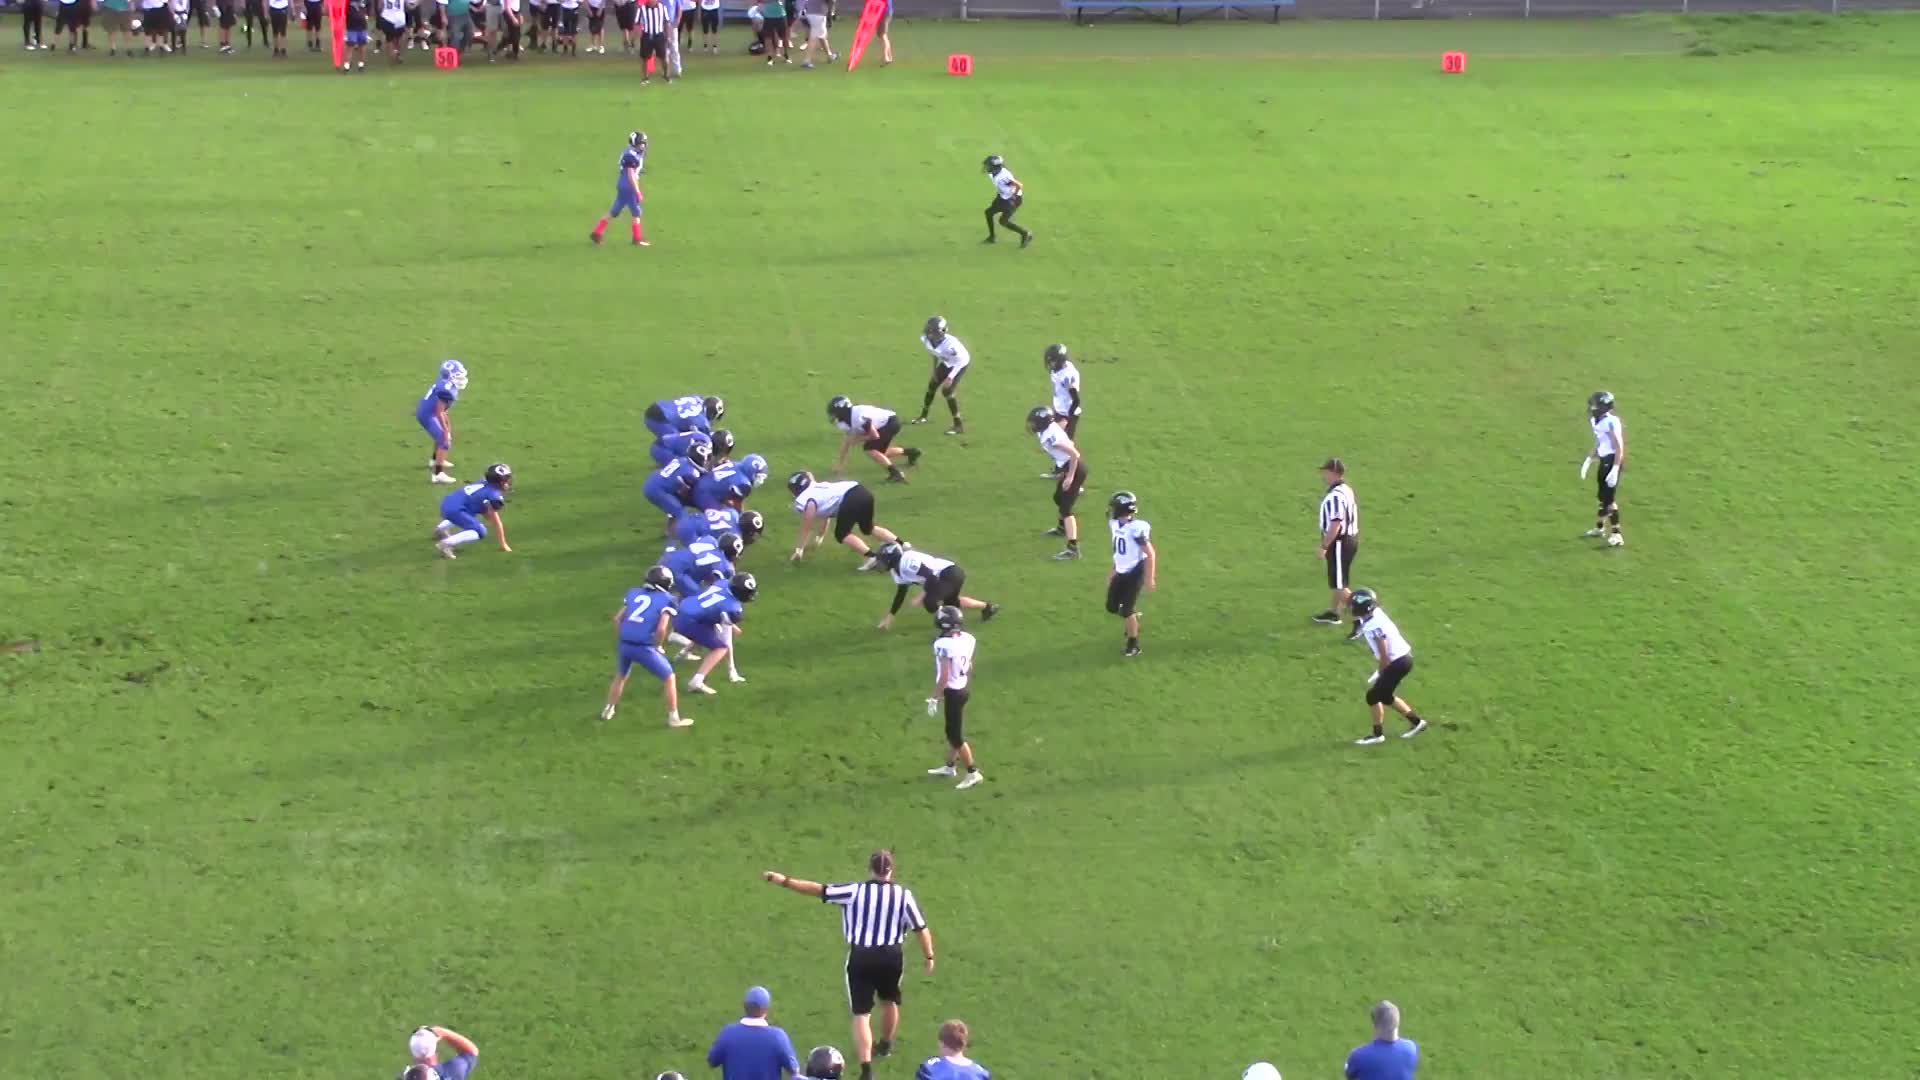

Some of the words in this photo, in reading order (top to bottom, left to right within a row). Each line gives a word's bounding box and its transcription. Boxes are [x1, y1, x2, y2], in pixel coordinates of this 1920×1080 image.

[438, 51, 454, 66] 50
[951, 57, 967, 73] 40
[1445, 55, 1462, 71] 30
[628, 594, 652, 623] 2
